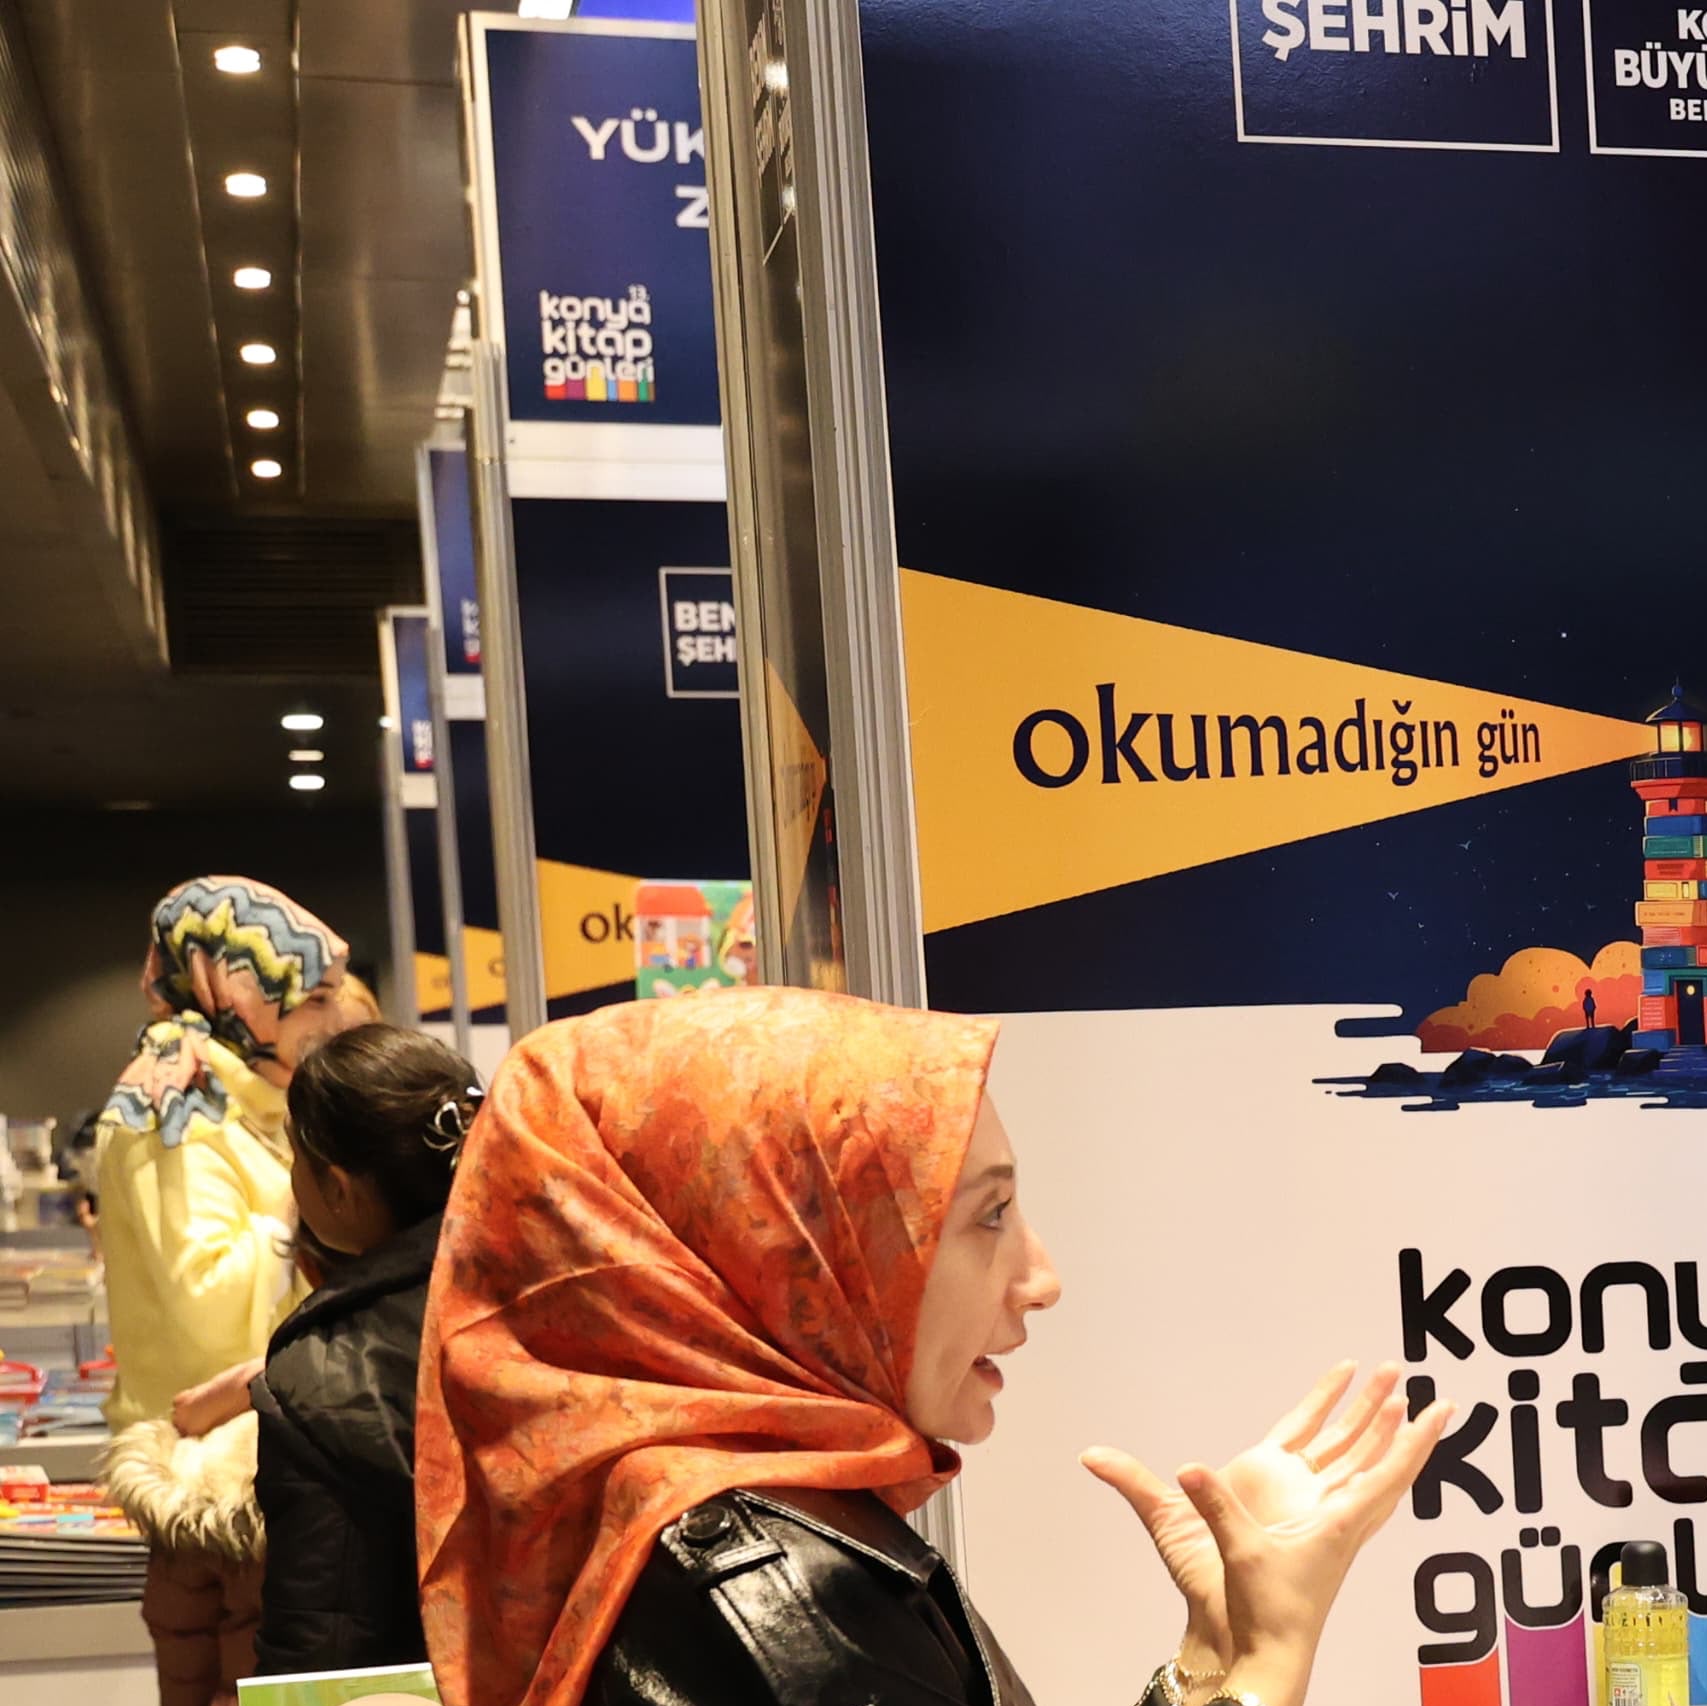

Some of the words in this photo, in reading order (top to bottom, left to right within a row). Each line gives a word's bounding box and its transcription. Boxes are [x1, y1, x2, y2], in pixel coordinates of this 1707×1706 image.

[539, 289, 651, 328] konya
[541, 320, 653, 362] kitap
[1012, 682, 1460, 789] okumadığın
[1477, 708, 1542, 777] gün
